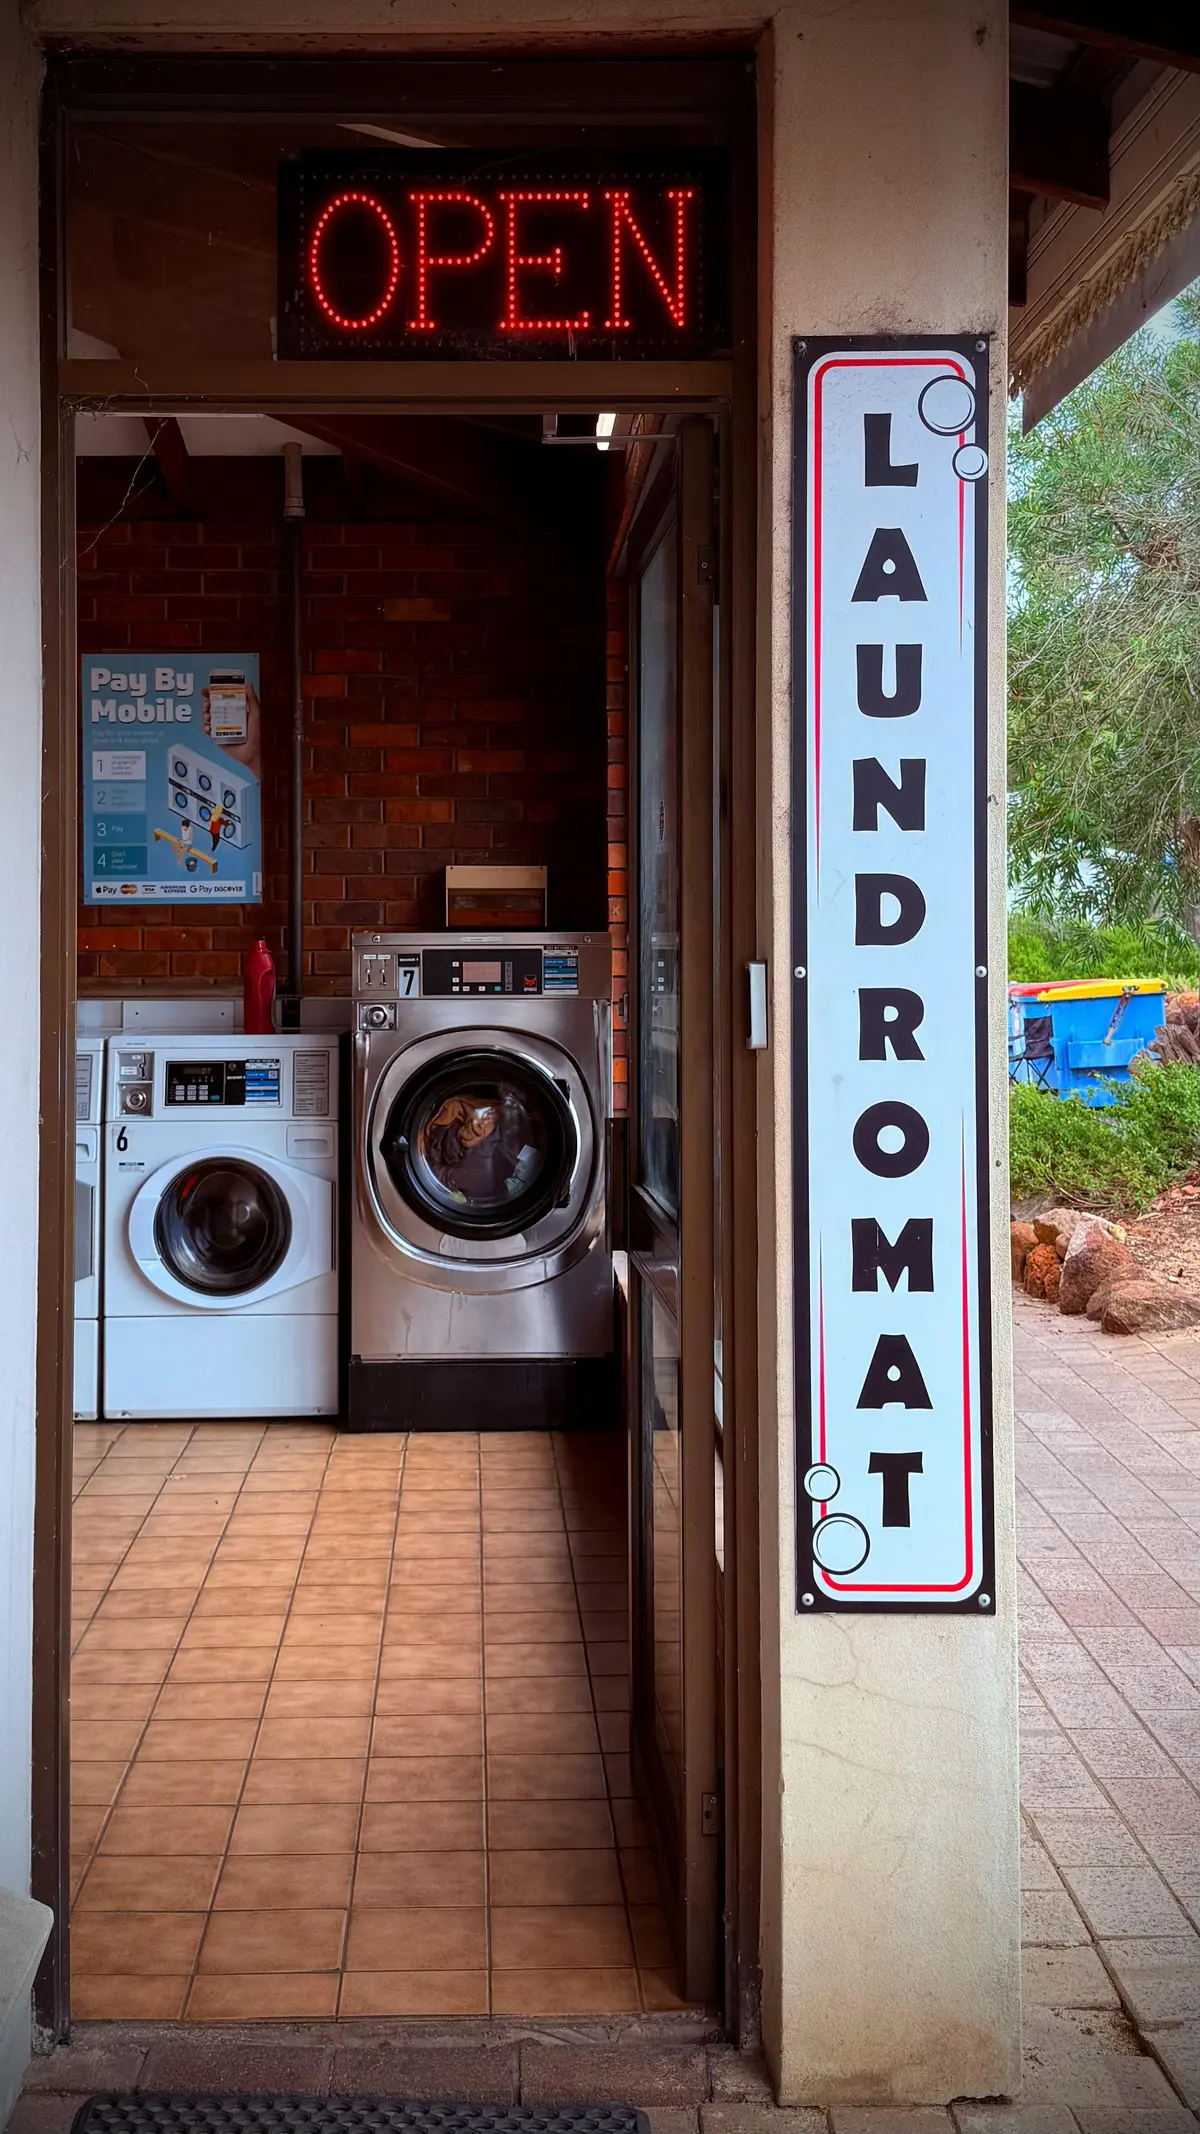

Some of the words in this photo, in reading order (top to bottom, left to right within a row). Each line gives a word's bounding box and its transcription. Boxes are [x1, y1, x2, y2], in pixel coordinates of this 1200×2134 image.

[308, 188, 694, 330] OPEN
[91, 668, 147, 697] Pay
[155, 668, 194, 697] By
[91, 698, 193, 723] Mobile
[96, 758, 104, 773] 1
[97, 790, 107, 805] 2
[97, 821, 107, 837] 3
[97, 853, 107, 868] 4
[102, 885, 118, 896] Pay
[199, 885, 213, 894] Pay
[851, 412, 935, 1529] LAUNDROMAT
[403, 970, 415, 996] 7
[117, 1126, 128, 1152] 6
